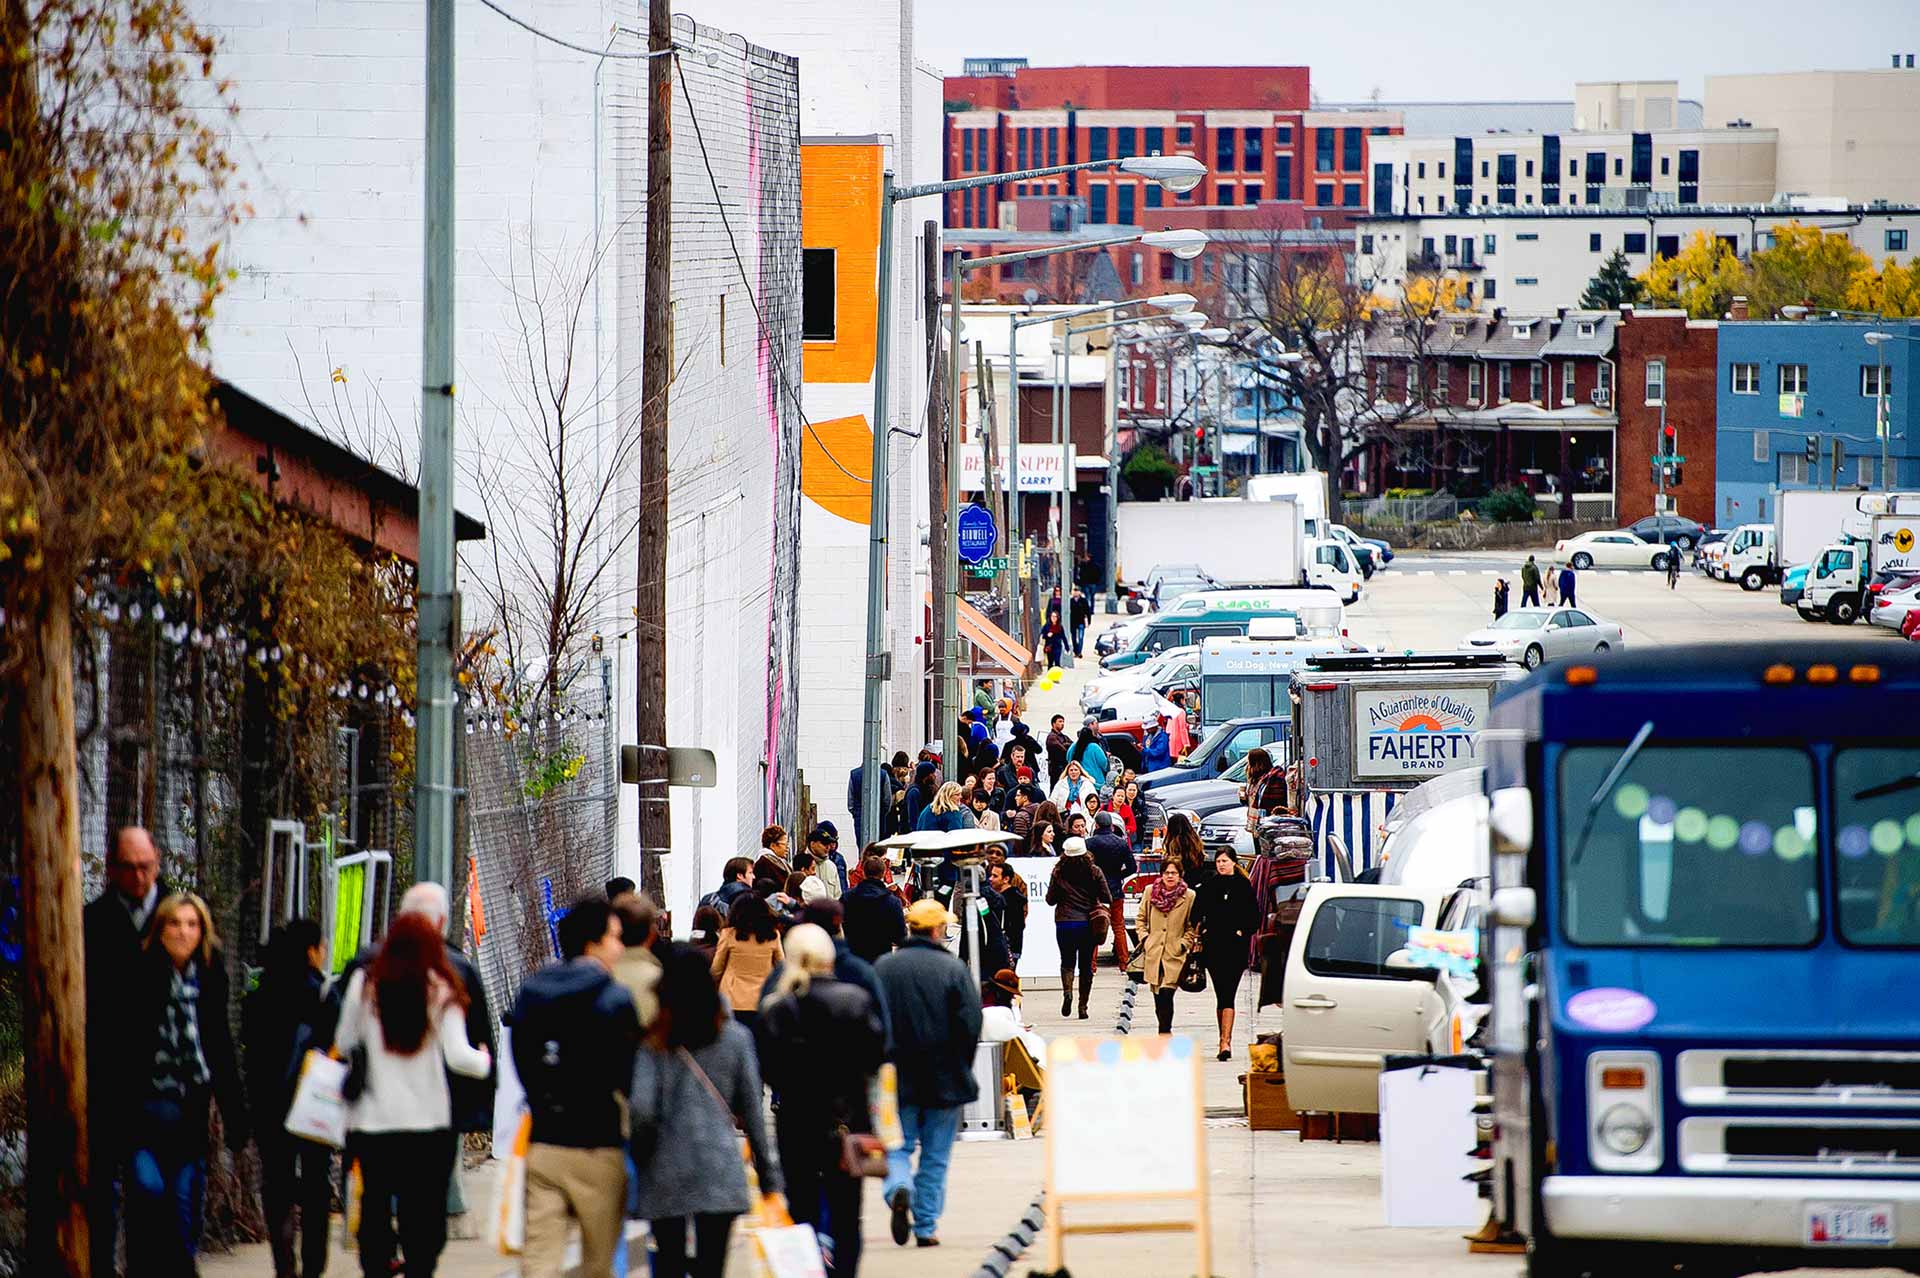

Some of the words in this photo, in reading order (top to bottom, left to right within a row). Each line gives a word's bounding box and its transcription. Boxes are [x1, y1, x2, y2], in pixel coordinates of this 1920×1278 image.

[1020, 476, 1053, 485] CARRY
[962, 529, 988, 540] BIDWELL
[1226, 660, 1242, 669] Old
[1269, 661, 1288, 669] New
[1369, 707, 1382, 726] A
[1379, 695, 1429, 718] Guarantee
[1430, 696, 1441, 709] of
[1440, 696, 1476, 726] Quality
[1369, 735, 1480, 760] FAHERTY
[1402, 760, 1445, 769] BRAND
